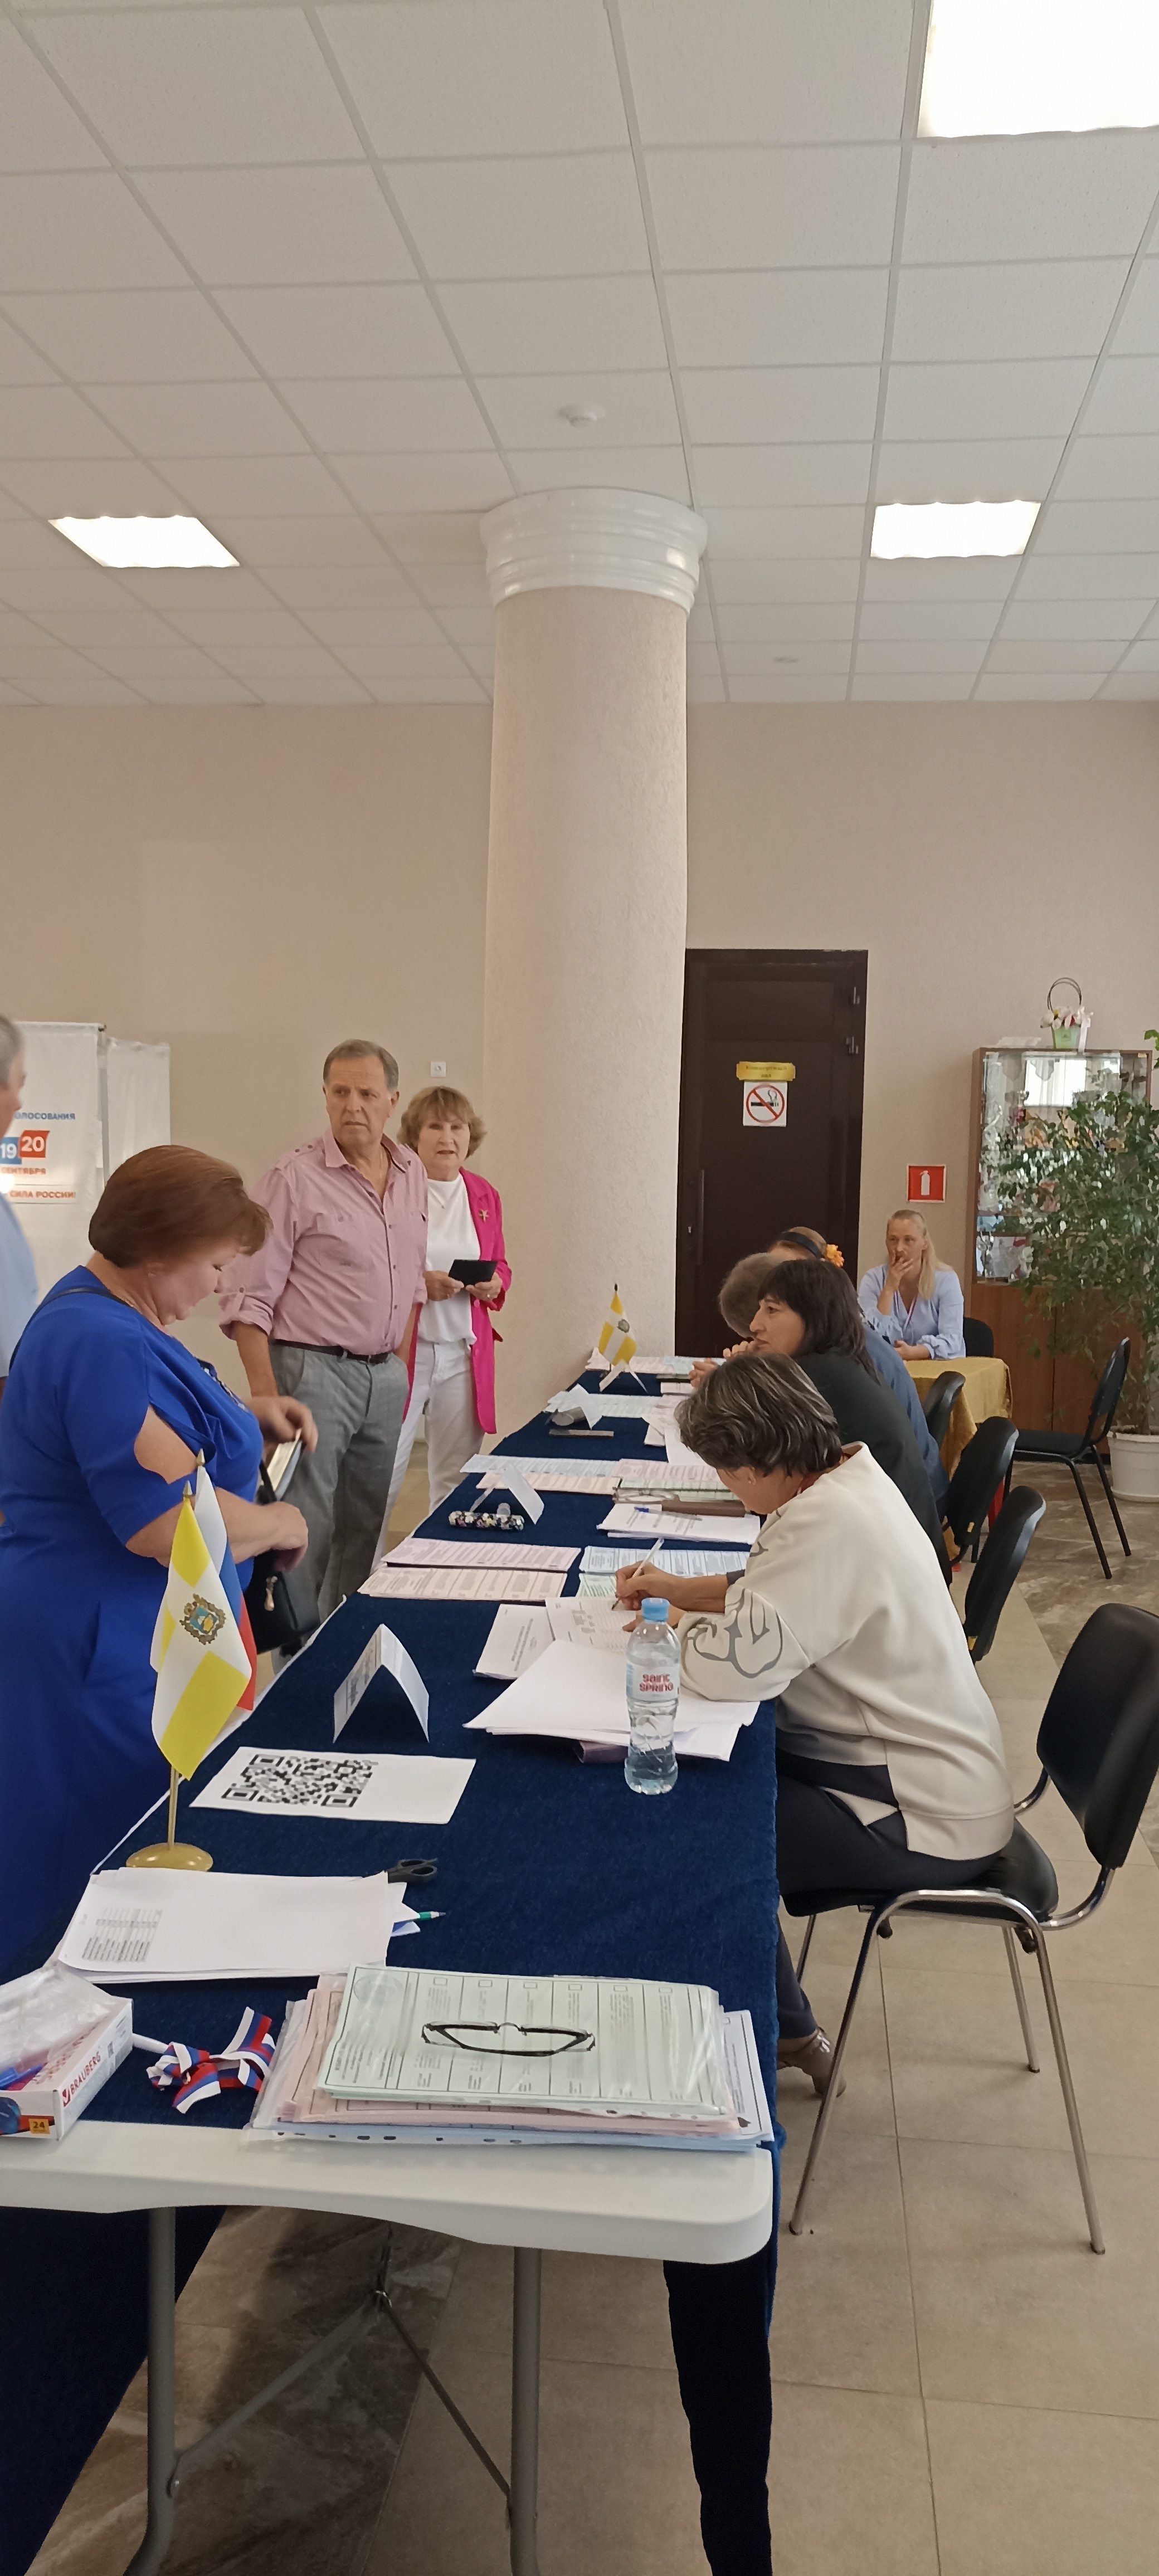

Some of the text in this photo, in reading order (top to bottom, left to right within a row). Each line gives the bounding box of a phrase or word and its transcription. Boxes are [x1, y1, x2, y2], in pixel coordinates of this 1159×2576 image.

[1, 1136, 45, 1158] 19 20
[70, 2052, 101, 2095] BRAUBERG
